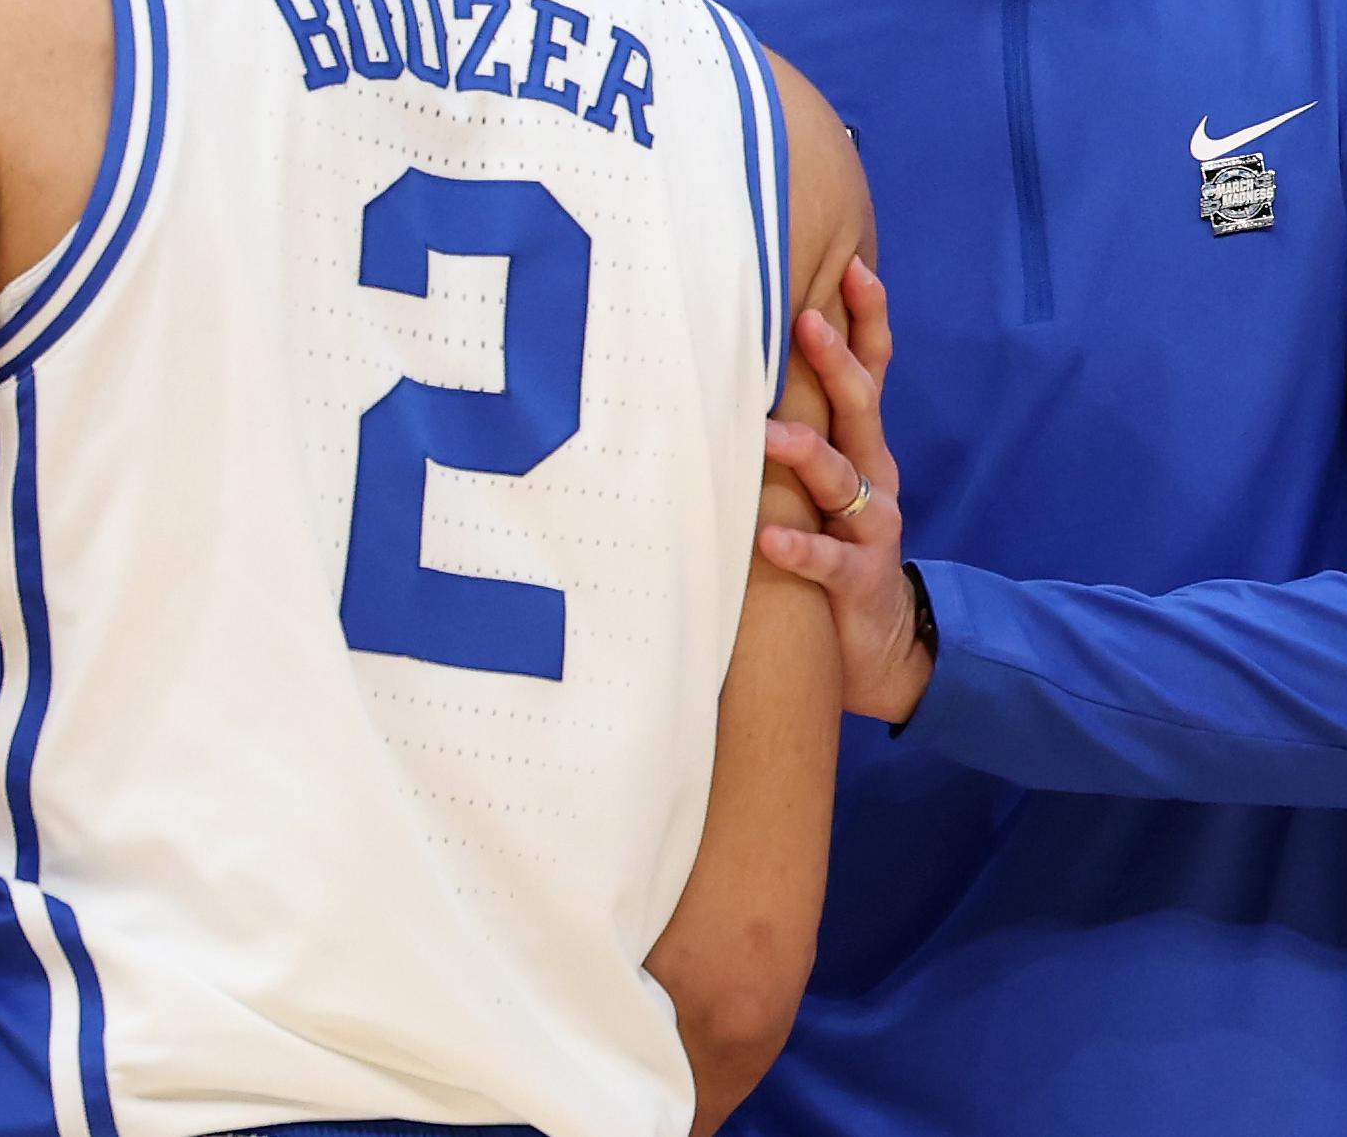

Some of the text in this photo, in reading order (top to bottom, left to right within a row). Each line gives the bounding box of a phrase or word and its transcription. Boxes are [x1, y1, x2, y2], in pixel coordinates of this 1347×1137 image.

[1217, 178, 1254, 195] MARCH
[1221, 188, 1274, 207] MADNESS
[340, 167, 592, 682] 2
